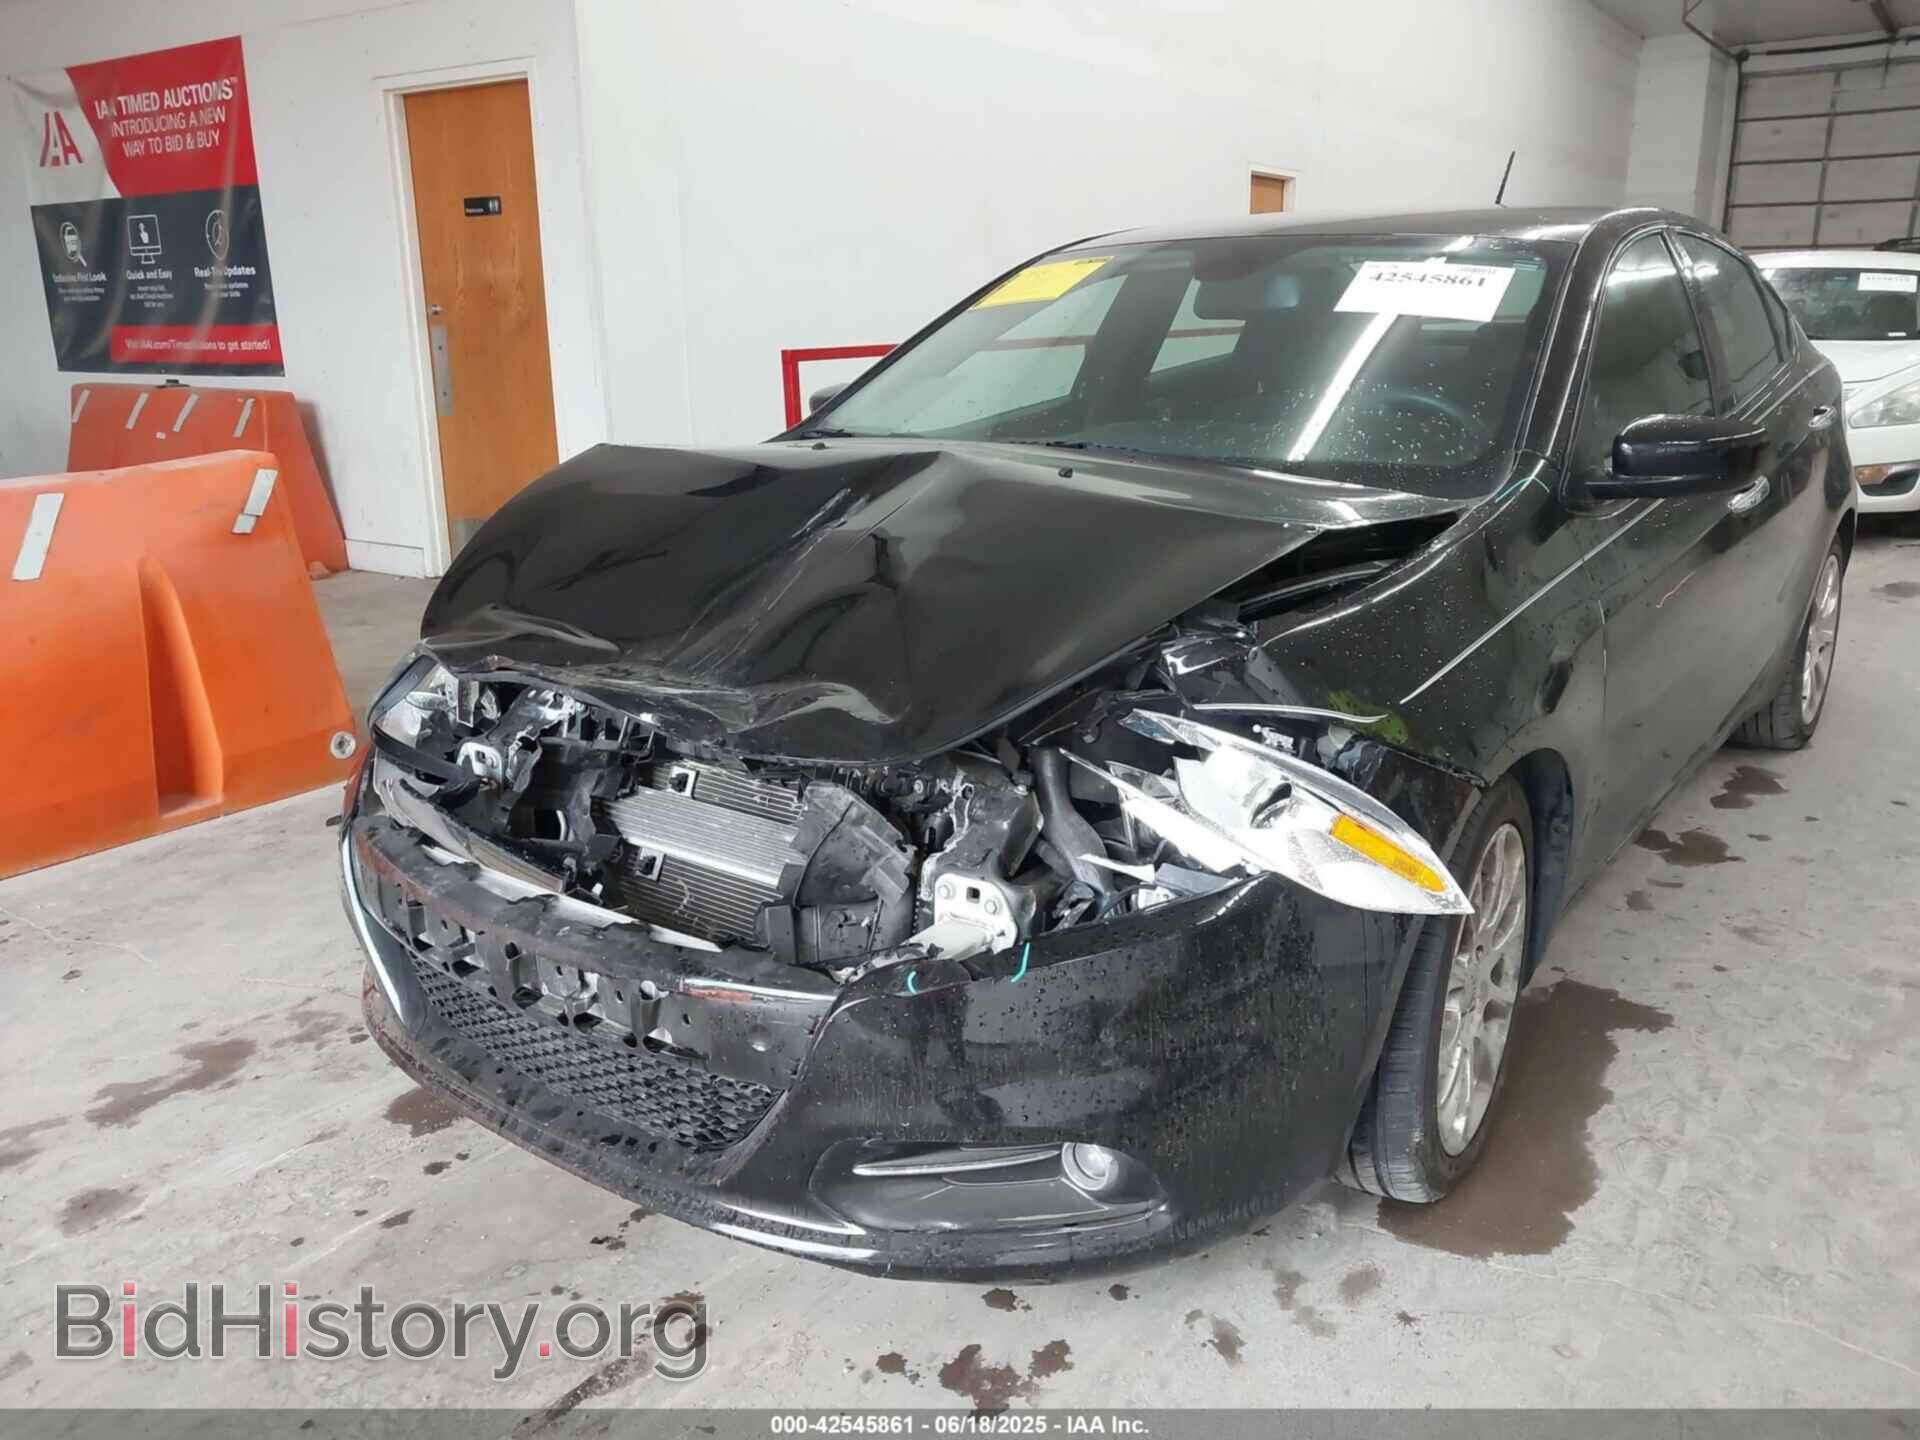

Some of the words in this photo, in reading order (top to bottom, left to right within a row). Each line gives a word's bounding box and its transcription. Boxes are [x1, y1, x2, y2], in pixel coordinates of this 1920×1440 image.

[117, 91, 160, 116] TIMED
[111, 112, 186, 138] INTRODUCING
[189, 111, 198, 128] A
[199, 105, 226, 126] NEW
[122, 140, 146, 158] WAY
[148, 136, 163, 155] TO
[165, 134, 183, 153] BID
[186, 132, 195, 150] &
[198, 129, 221, 149] BUY
[126, 270, 145, 280] Quick
[146, 269, 158, 280] and
[159, 268, 173, 280] Easy
[1368, 272, 1486, 287] 42545861
